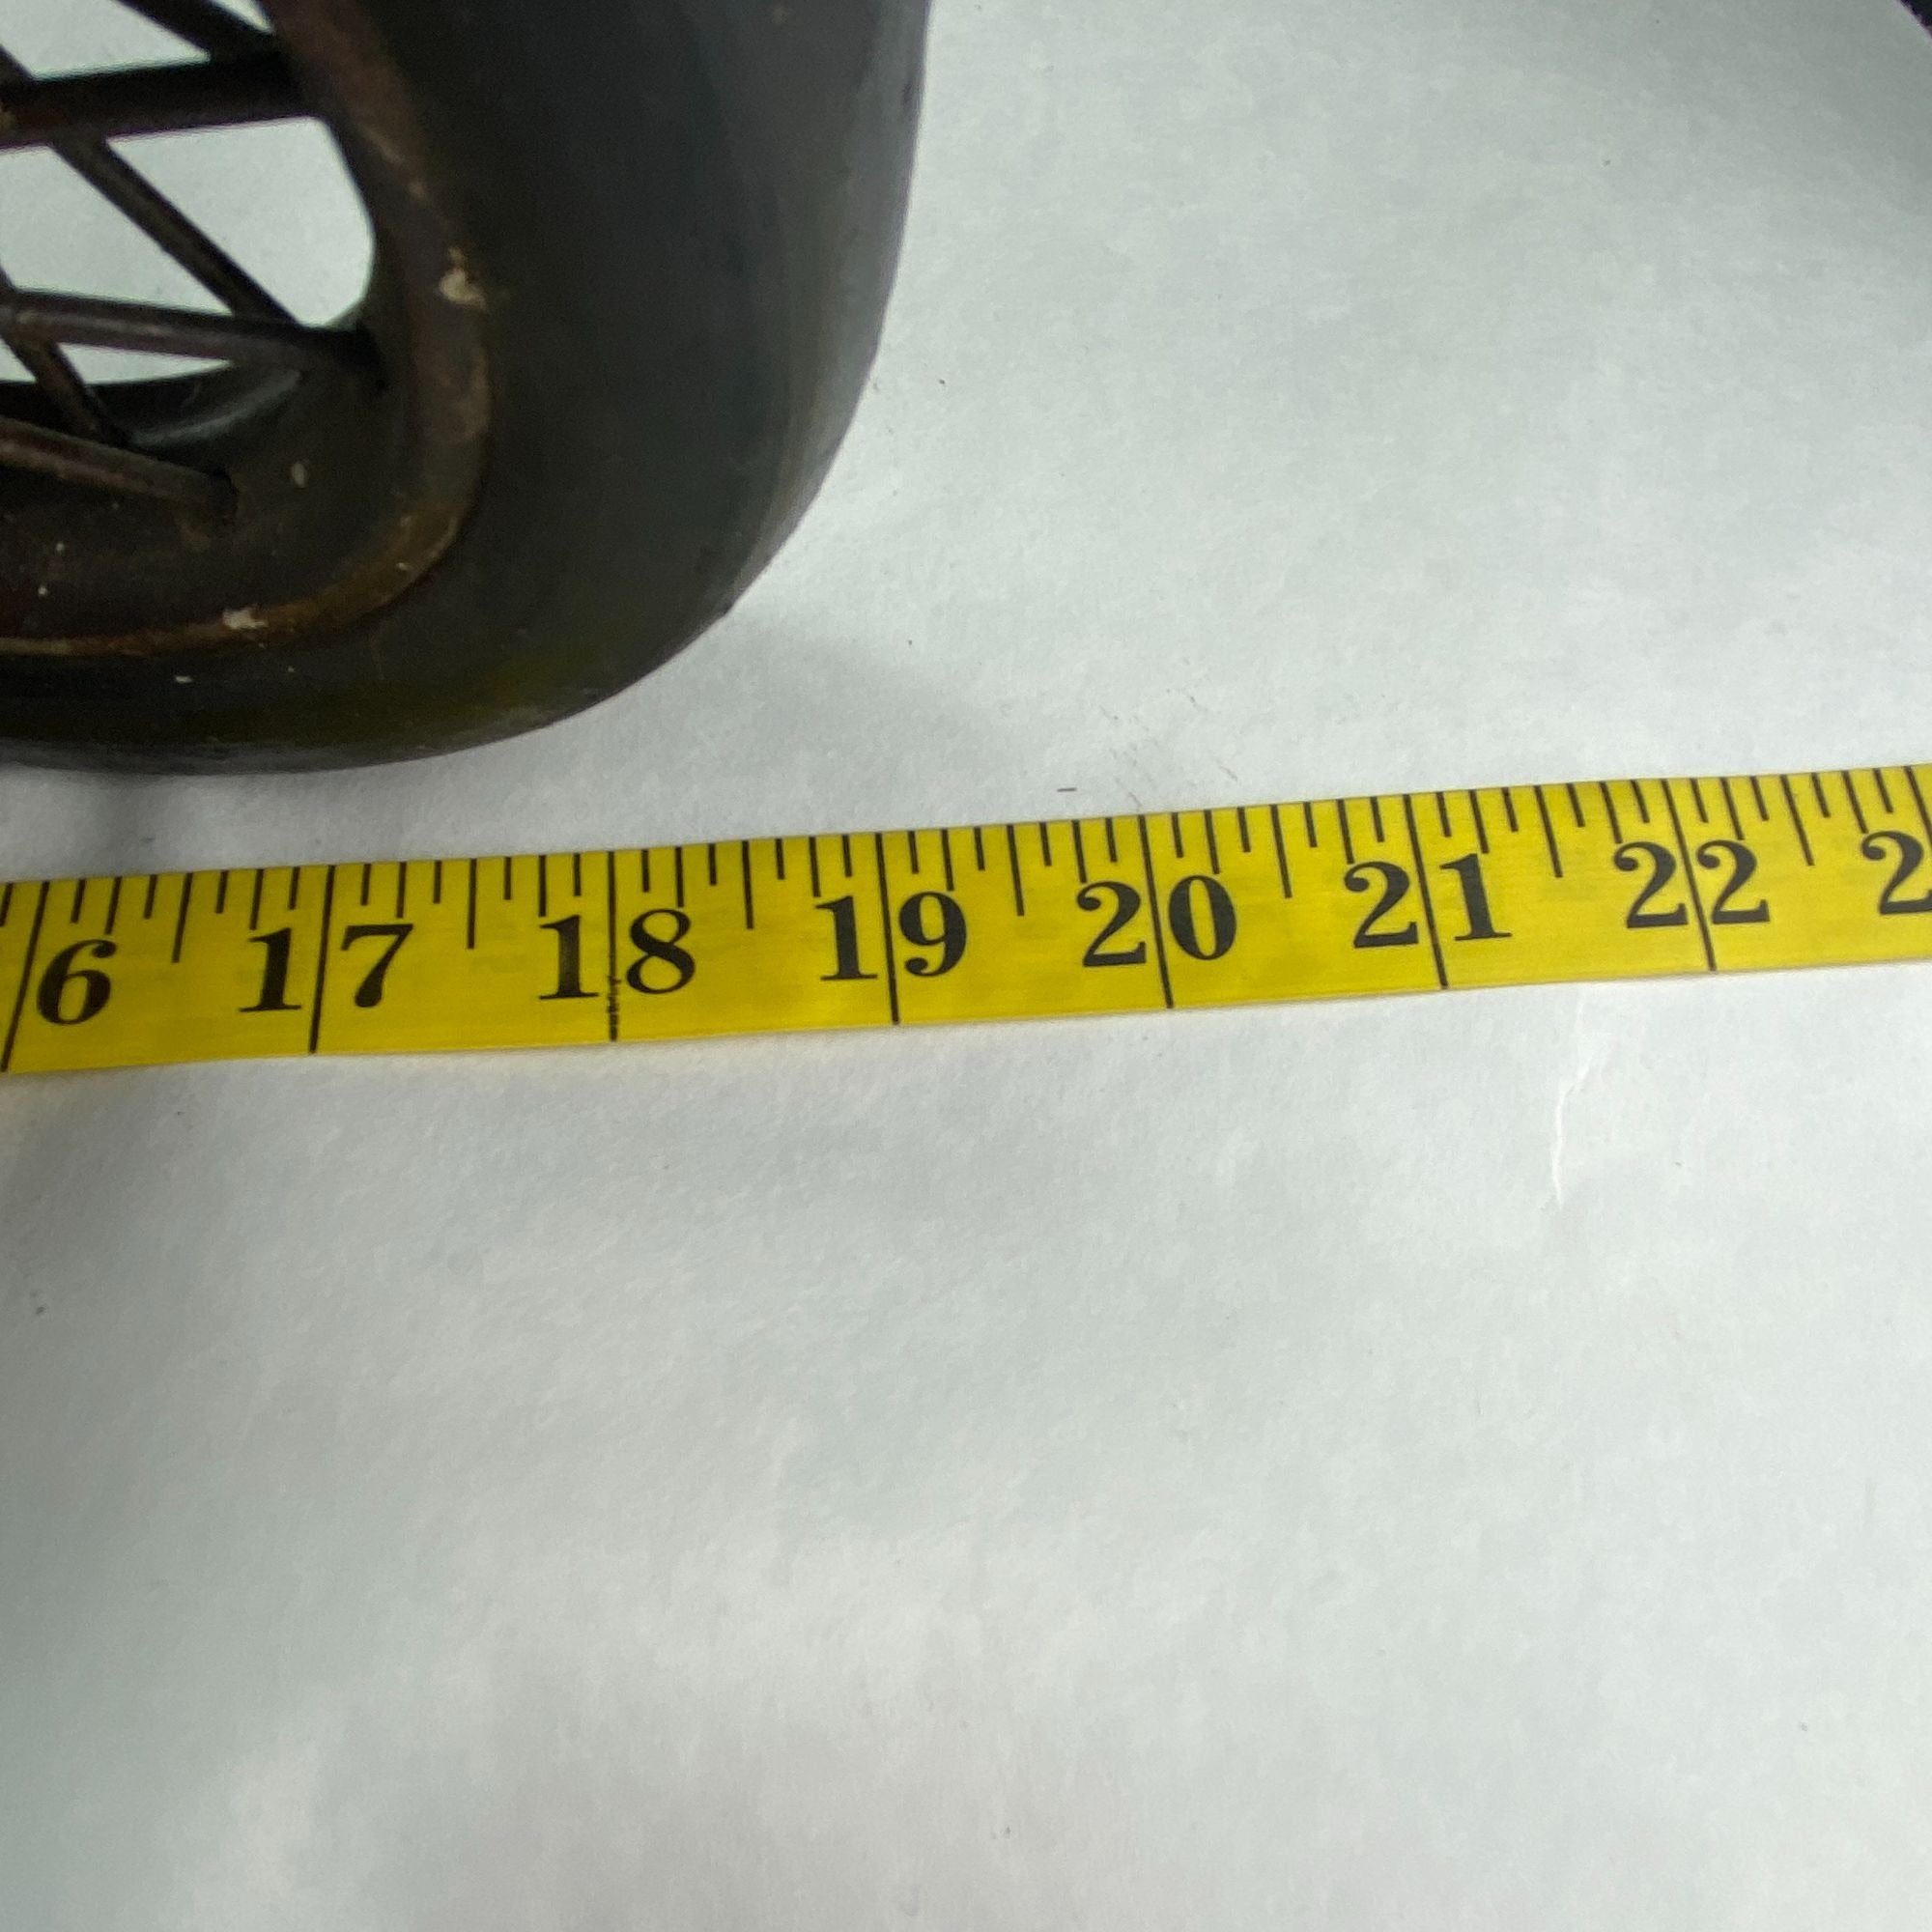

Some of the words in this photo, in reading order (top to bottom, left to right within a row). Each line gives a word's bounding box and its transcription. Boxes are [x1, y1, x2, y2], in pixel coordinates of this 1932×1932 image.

[37, 938, 117, 1026] 6
[238, 923, 414, 1013] 17
[537, 908, 696, 1001] 18
[814, 891, 967, 981] 19
[1075, 874, 1237, 969] 20
[1343, 852, 1513, 950] 21
[1612, 838, 1771, 929] 22
